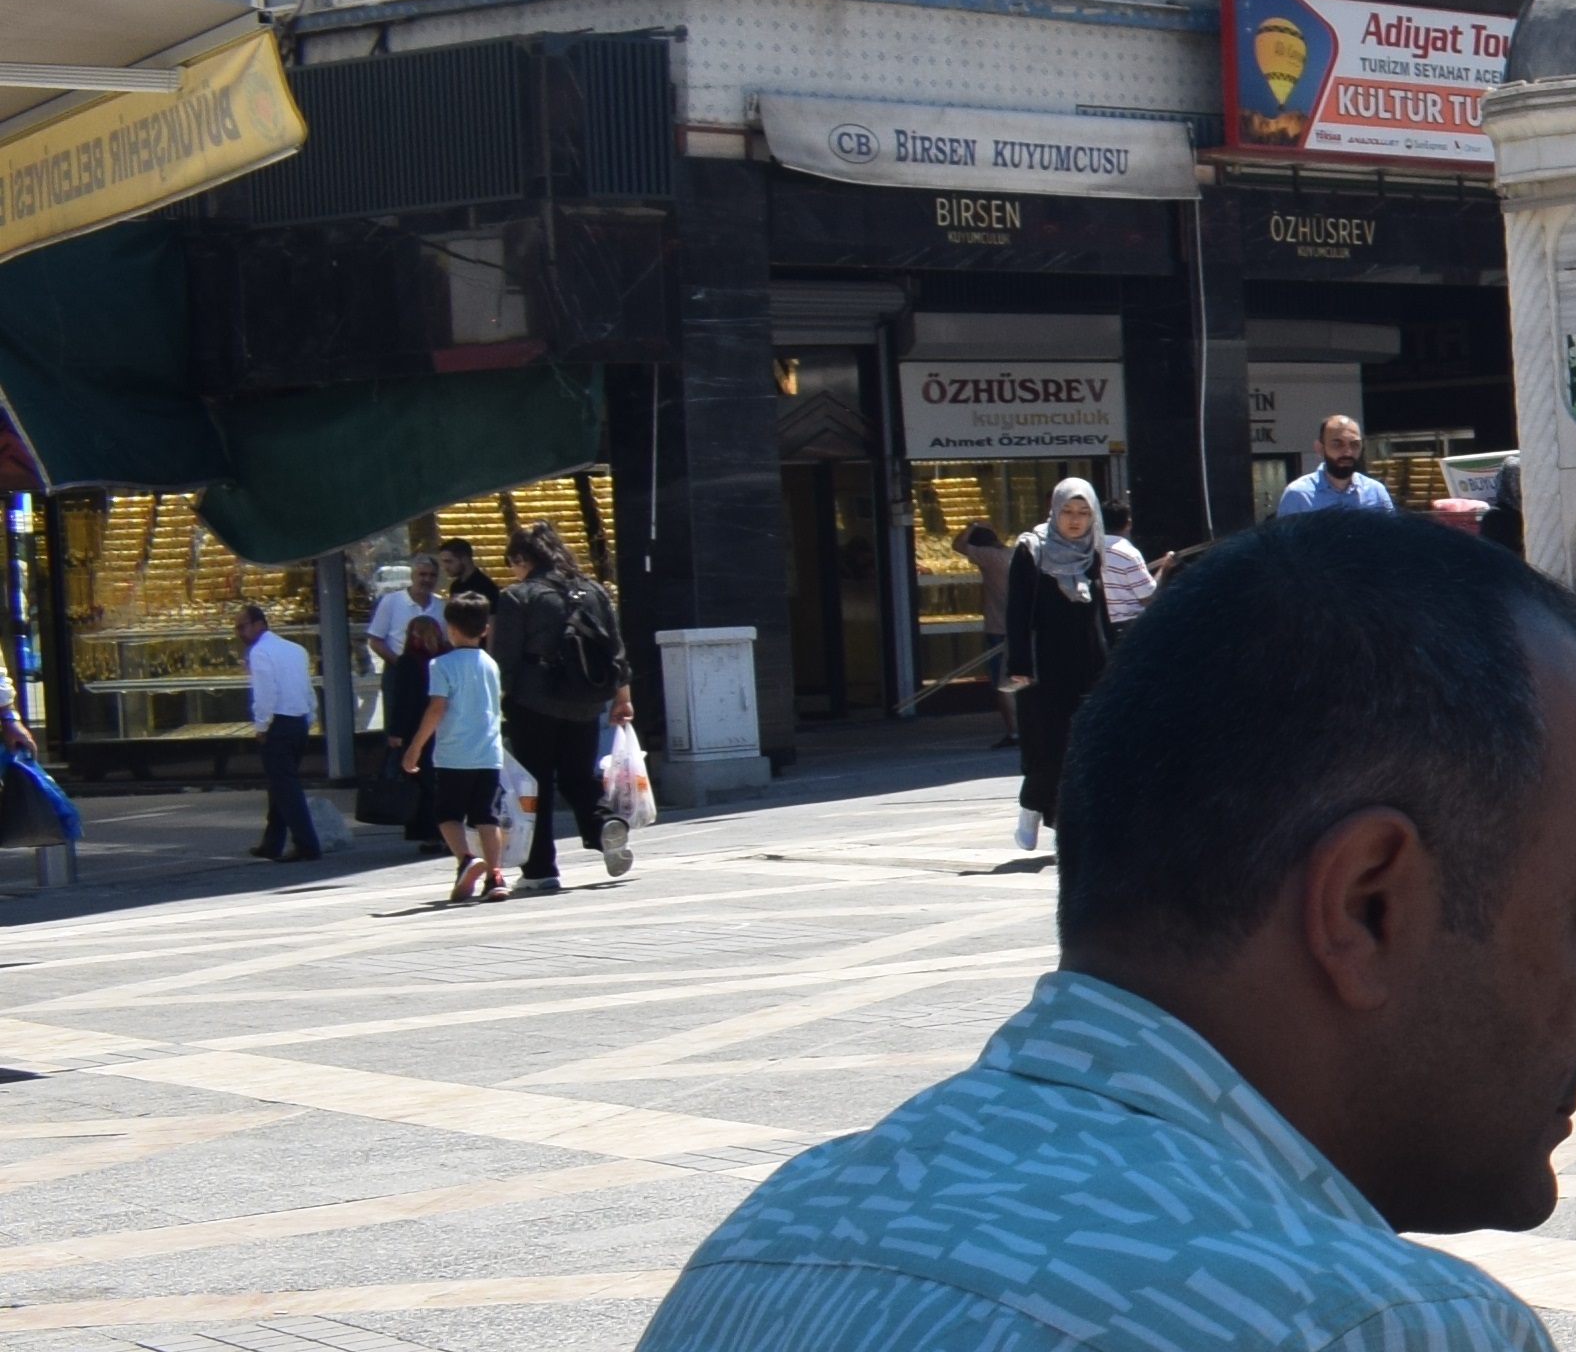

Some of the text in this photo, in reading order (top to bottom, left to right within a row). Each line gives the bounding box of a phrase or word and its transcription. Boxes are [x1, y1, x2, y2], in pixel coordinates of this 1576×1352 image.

[1361, 12, 1464, 59] Adiyat
[1360, 56, 1411, 77] TURİZM
[1414, 63, 1471, 83] SEYAHAT
[1338, 83, 1445, 125] KÜLTÜR
[836, 129, 1129, 175] CB BİRSEN KUYUMCUSU
[935, 193, 1022, 228] BİRSEN
[1270, 210, 1376, 245] ÖZHÜSREV
[922, 372, 1109, 405] ÖZHÜSREV
[971, 409, 1109, 430] kuyumculuk
[930, 433, 1109, 448] Ahmet ÖZHÜSREV
